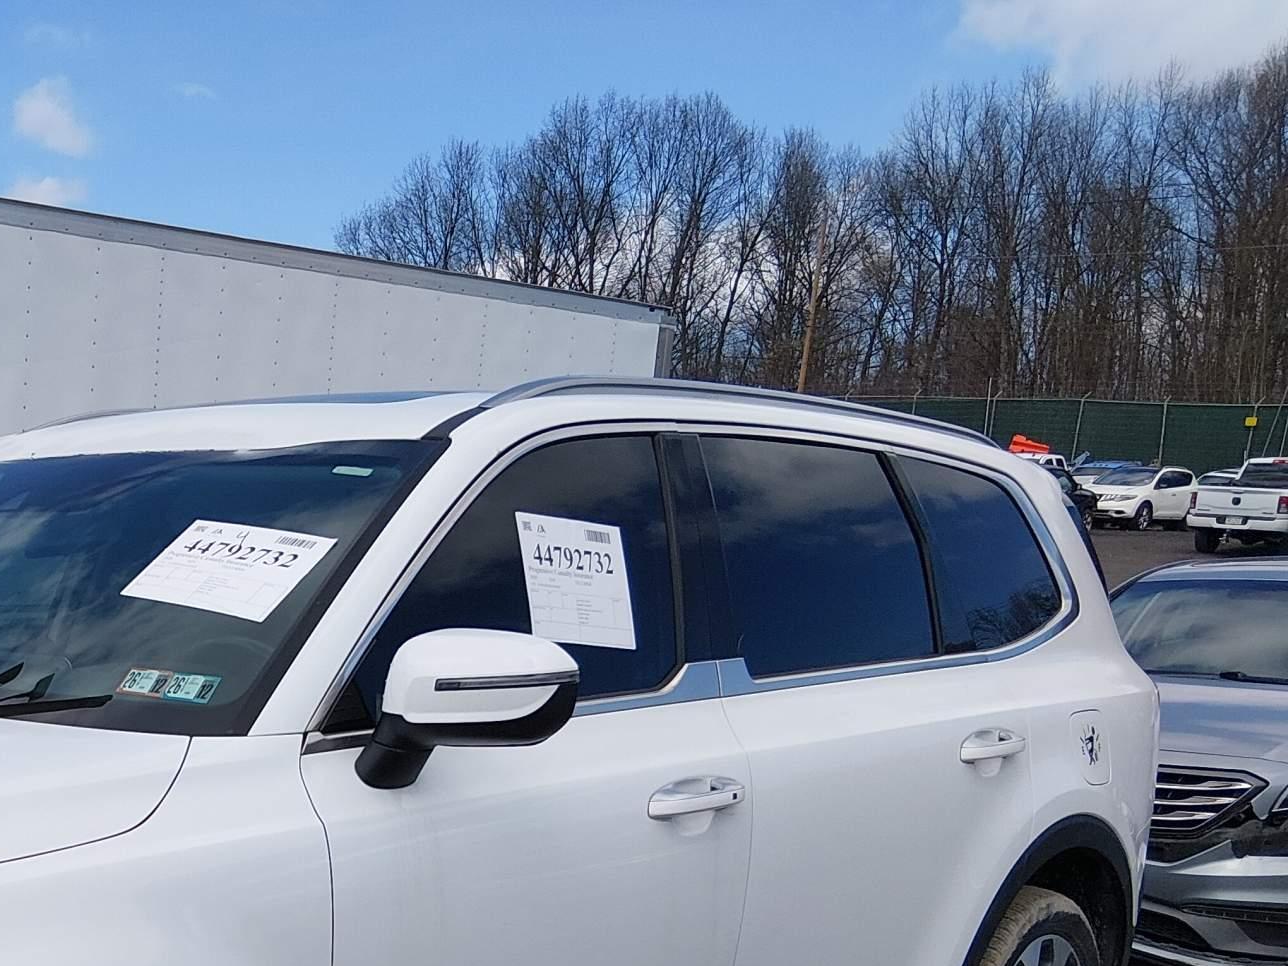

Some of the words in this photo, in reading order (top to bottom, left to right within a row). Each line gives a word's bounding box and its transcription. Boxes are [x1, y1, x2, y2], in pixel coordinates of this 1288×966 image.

[184, 539, 299, 569] 44792732
[533, 543, 614, 575] 44792732
[122, 671, 142, 689] 26
[151, 678, 168, 694] 12
[167, 676, 186, 695] 26
[196, 683, 214, 699] 12
